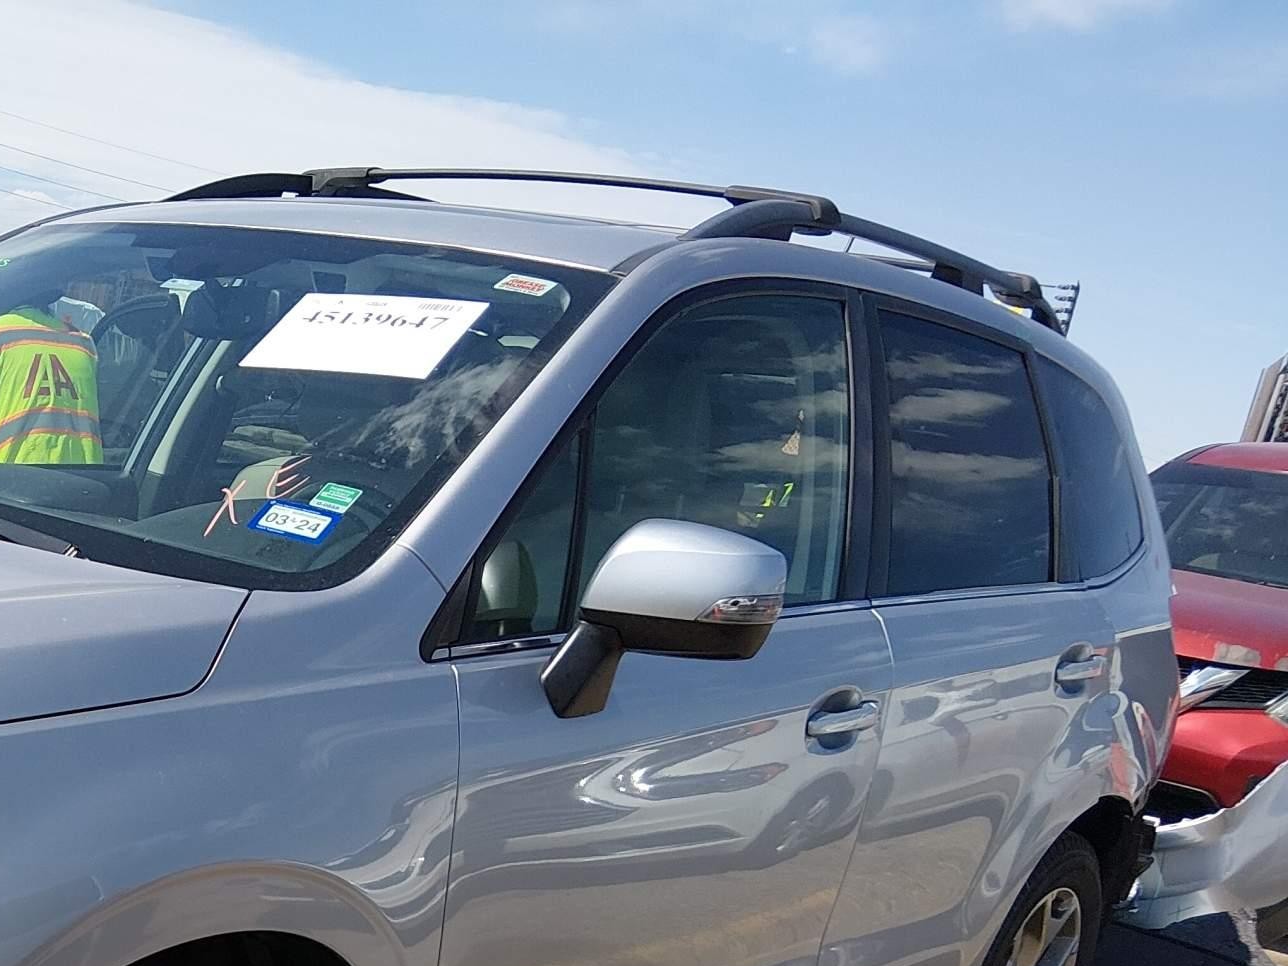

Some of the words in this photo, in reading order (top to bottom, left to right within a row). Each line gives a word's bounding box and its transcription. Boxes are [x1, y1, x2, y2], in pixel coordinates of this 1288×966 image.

[303, 310, 449, 330] 45139647
[265, 512, 290, 526] 03
[292, 519, 321, 534] 24
